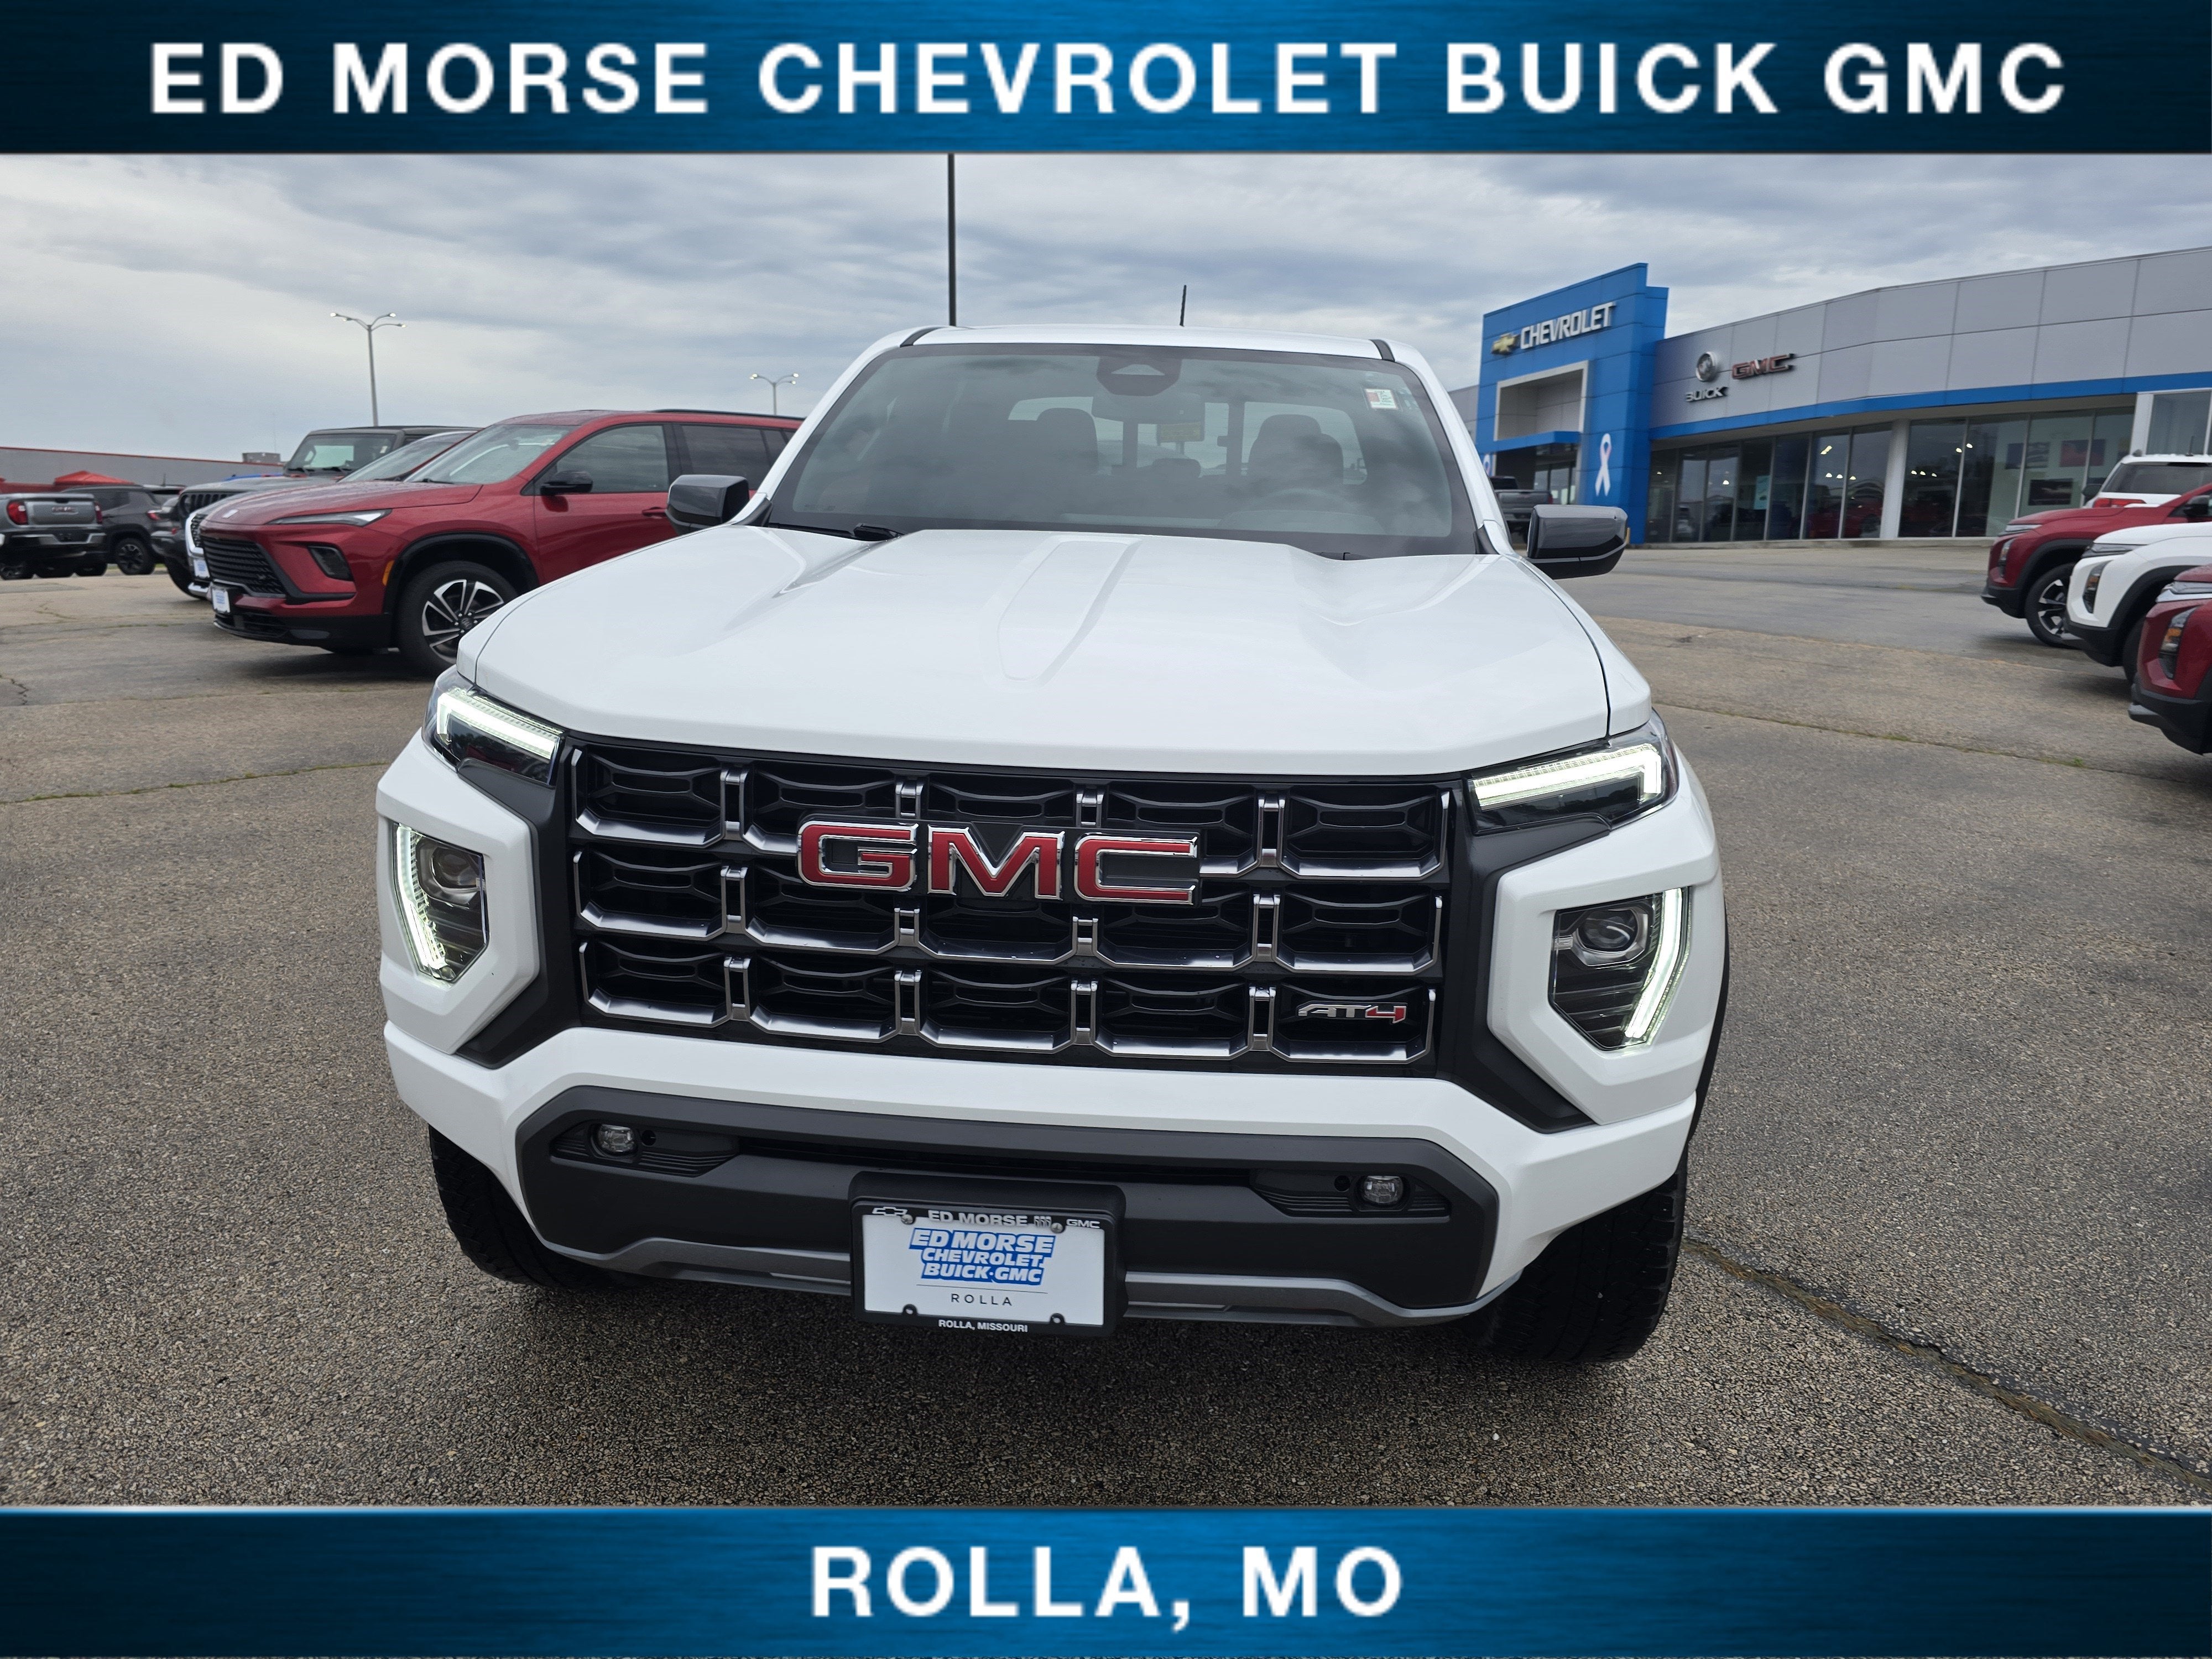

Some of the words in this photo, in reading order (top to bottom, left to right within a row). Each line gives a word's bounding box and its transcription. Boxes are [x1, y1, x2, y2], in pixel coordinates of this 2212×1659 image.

[1521, 301, 1616, 349] CHEVROLET
[1731, 354, 1793, 379] GMC
[1685, 386, 1726, 402] BUICK
[797, 821, 1197, 905] GMC
[1298, 1004, 1407, 1024] AT4
[928, 1210, 953, 1222] ED
[958, 1212, 1028, 1227] MORSE
[1066, 1218, 1100, 1229] GMC
[911, 1229, 950, 1248] ED
[951, 1231, 1055, 1254] MORSE
[922, 1247, 1043, 1267] CHEVROLET
[951, 1293, 1012, 1306] ROLLA
[938, 1319, 975, 1330] ROLLA,
[977, 1322, 1028, 1332] MISSOURI
